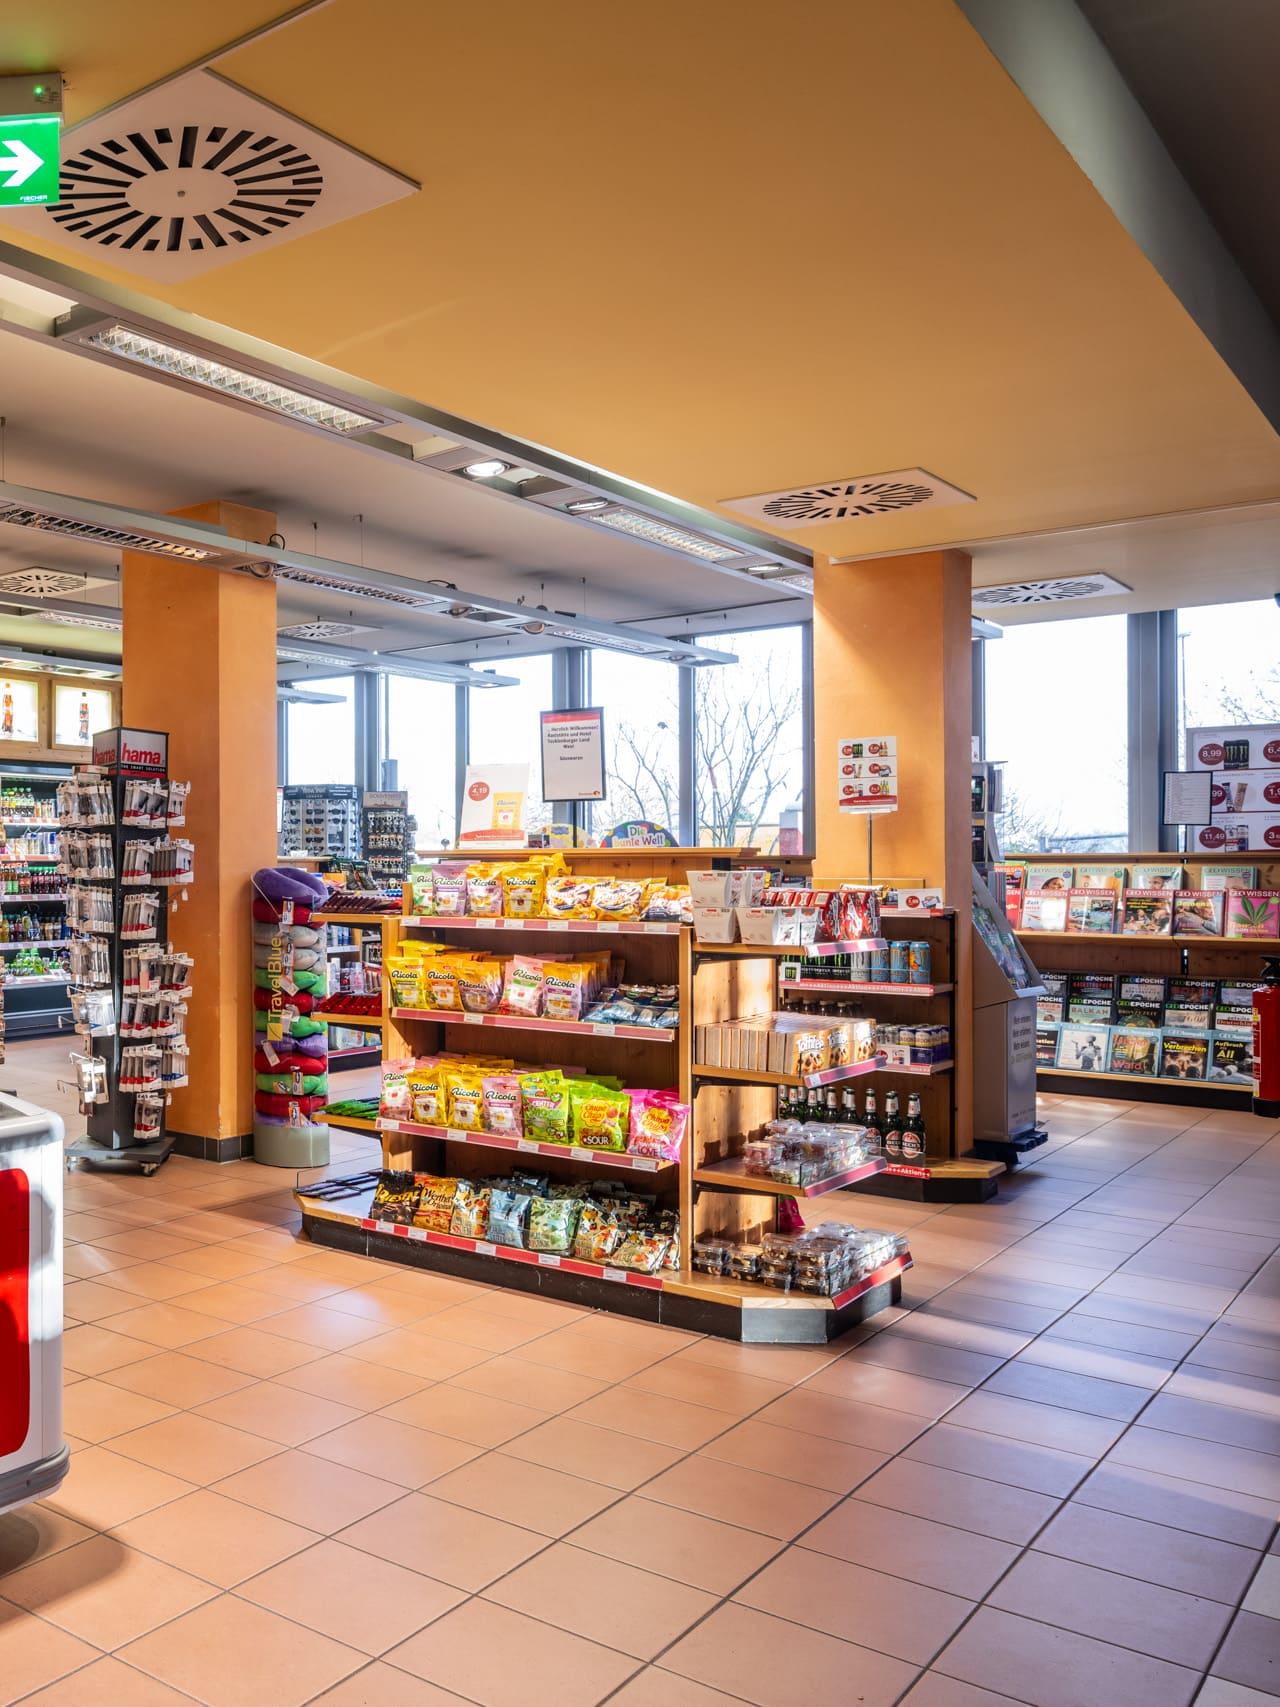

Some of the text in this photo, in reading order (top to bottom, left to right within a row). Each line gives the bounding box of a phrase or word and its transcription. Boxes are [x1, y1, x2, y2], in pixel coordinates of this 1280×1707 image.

[122, 742, 161, 765] hama
[629, 825, 646, 836] Die
[641, 834, 664, 846] Welt
[435, 878, 463, 886] Ricola
[506, 877, 536, 886] Ricola
[1247, 890, 1280, 898] WISSEN
[391, 970, 418, 979] Ricola
[427, 971, 455, 980] Ricola
[513, 969, 542, 982] Ricola
[458, 979, 487, 990] Ricola
[545, 977, 576, 989] Ricola
[1072, 1007, 1109, 1015] BALKAN
[1163, 1042, 1207, 1053] Verbrechen
[1216, 1050, 1235, 1059] All
[1112, 1059, 1142, 1070] Wald
[411, 1083, 439, 1092] Ricola
[451, 1087, 480, 1098] Ricola
[486, 1090, 517, 1101] Ricola
[585, 1102, 608, 1112] Chupa
[586, 1134, 609, 1145] SOUR
[637, 1146, 658, 1156] LOVE
[376, 1183, 419, 1204] RIESEN
